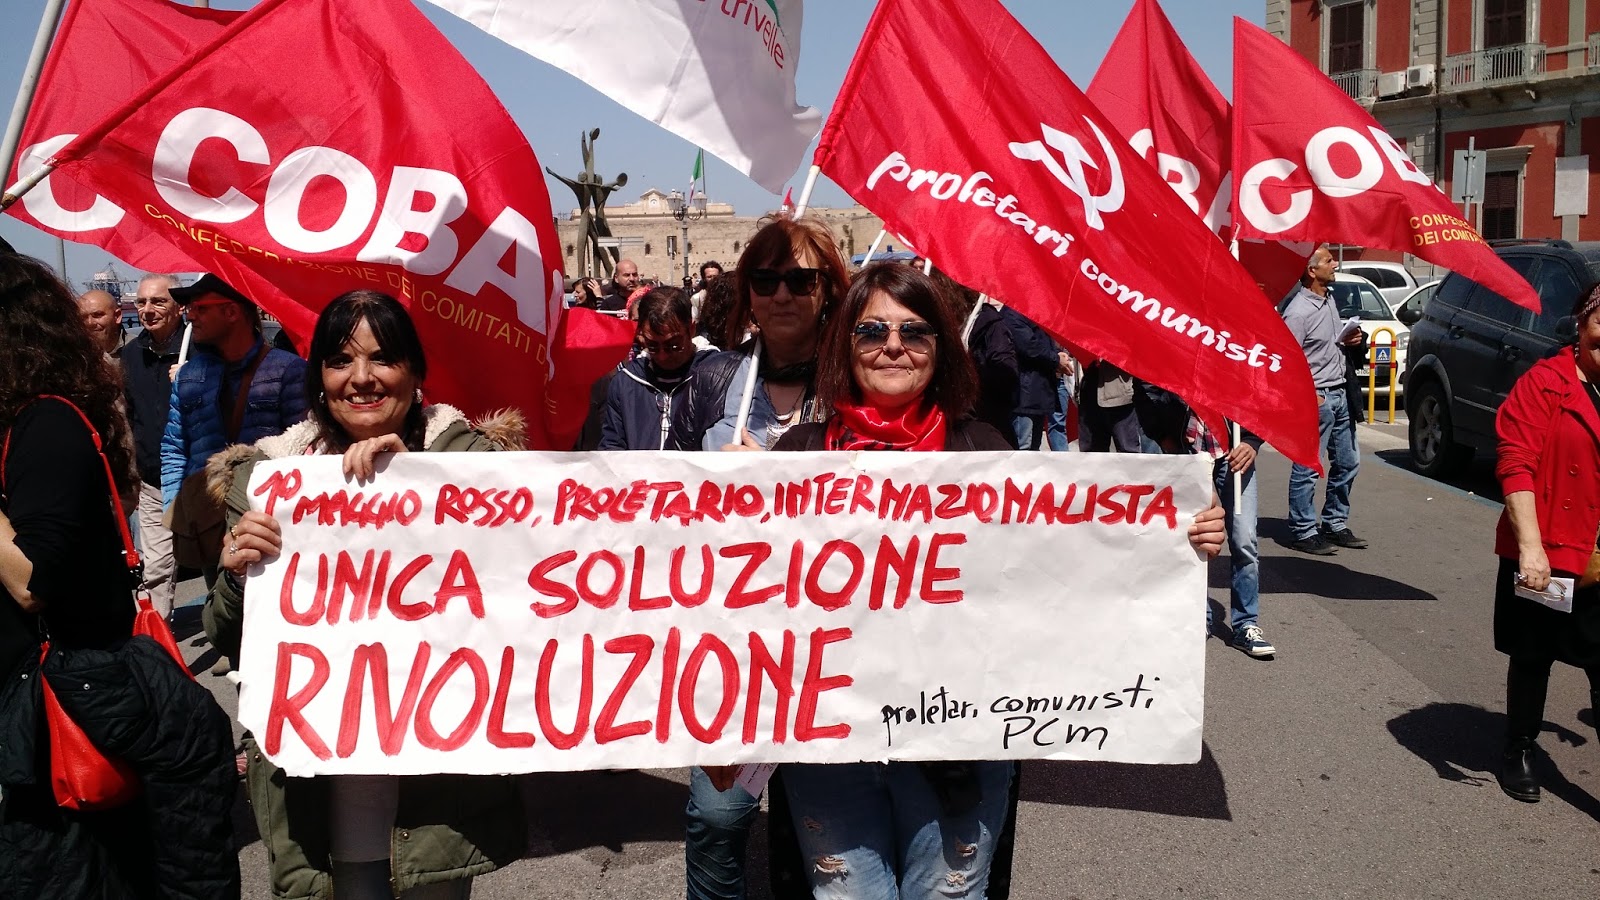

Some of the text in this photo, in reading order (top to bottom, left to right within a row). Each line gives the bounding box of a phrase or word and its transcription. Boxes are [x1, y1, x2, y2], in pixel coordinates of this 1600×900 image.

[720, 0, 785, 69] trivelle
[152, 107, 564, 381] COBA
[866, 151, 1283, 372] proletari comunisti
[1414, 232, 1440, 247] DEI
[386, 271, 416, 302] DEI
[421, 290, 531, 353] COMITATI
[291, 488, 423, 530] MAGGIO
[434, 484, 542, 528] ROSSO,
[280, 533, 967, 626] UNICA SOLUZIONE
[990, 674, 1160, 713] comunisti
